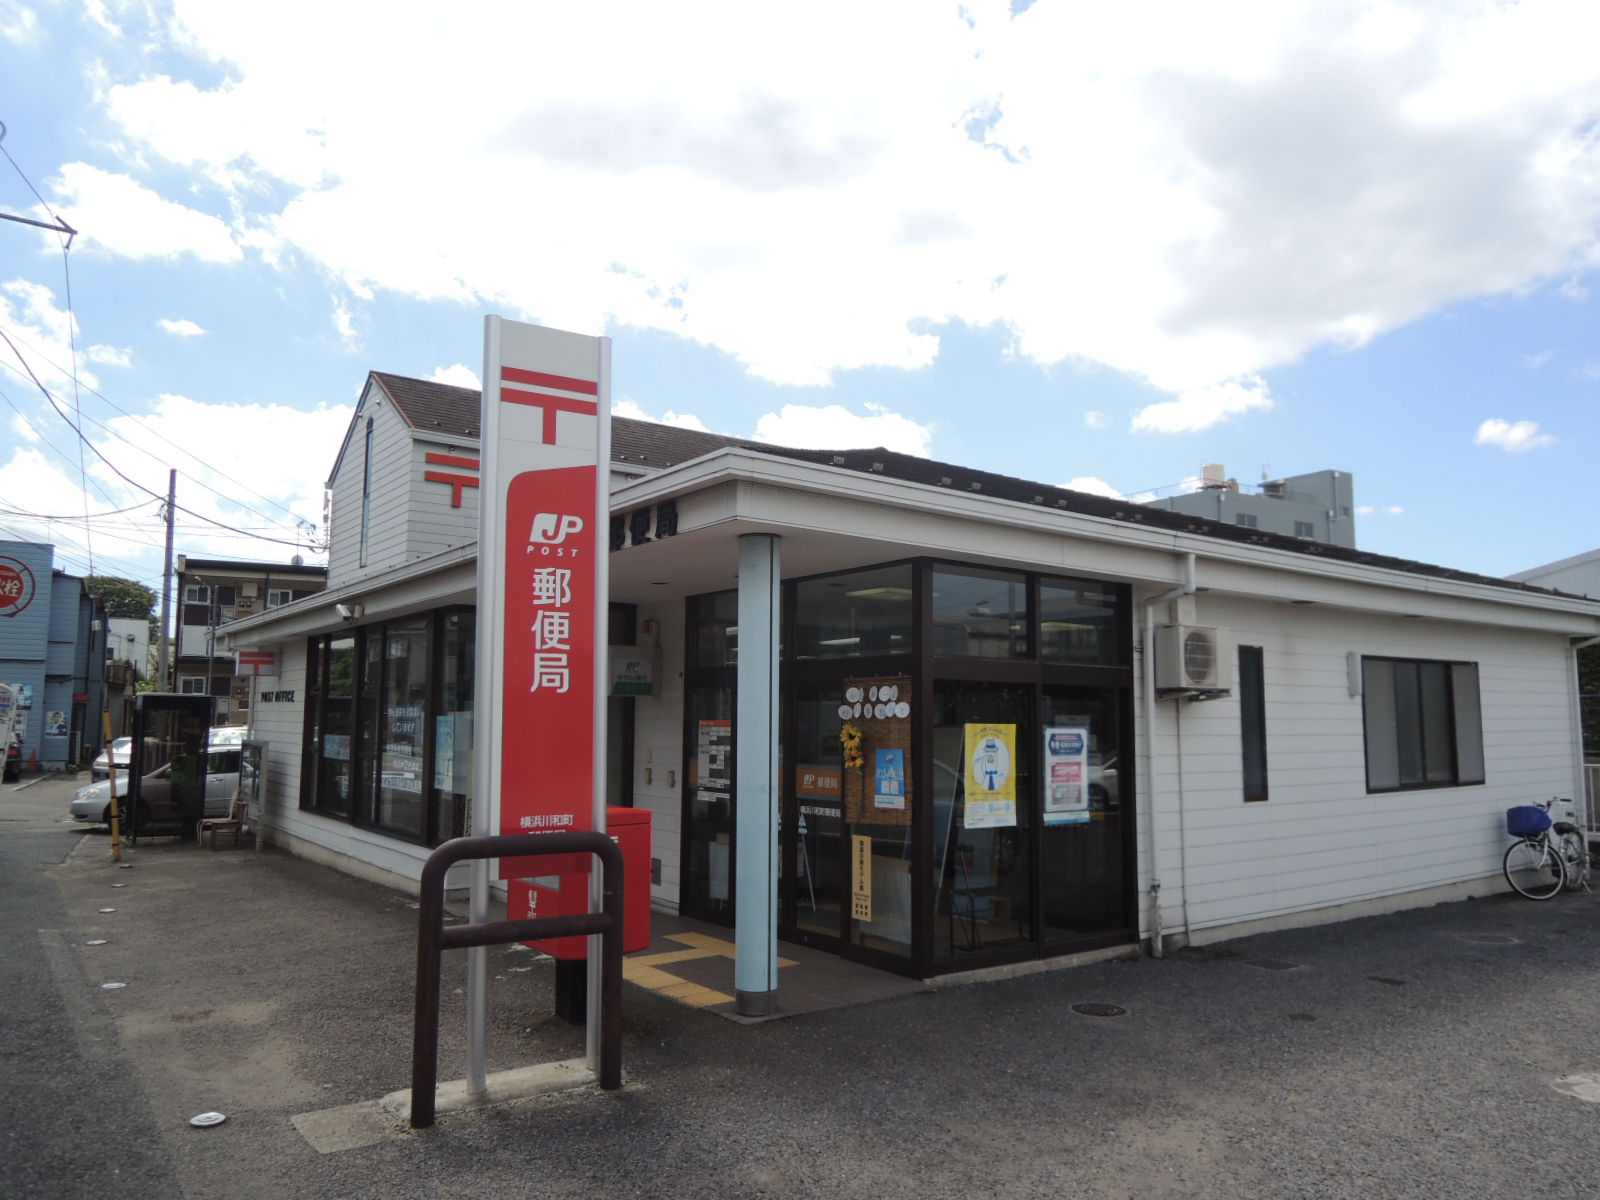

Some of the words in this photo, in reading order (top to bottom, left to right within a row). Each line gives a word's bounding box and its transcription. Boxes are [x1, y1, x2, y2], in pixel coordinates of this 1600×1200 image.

[527, 545, 579, 558] POST
[530, 567, 572, 694] 郵便局
[261, 691, 274, 703] POST
[274, 690, 295, 703] OFFICE
[817, 777, 838, 789] 郵便局
[520, 814, 574, 829] 横浜川和町
